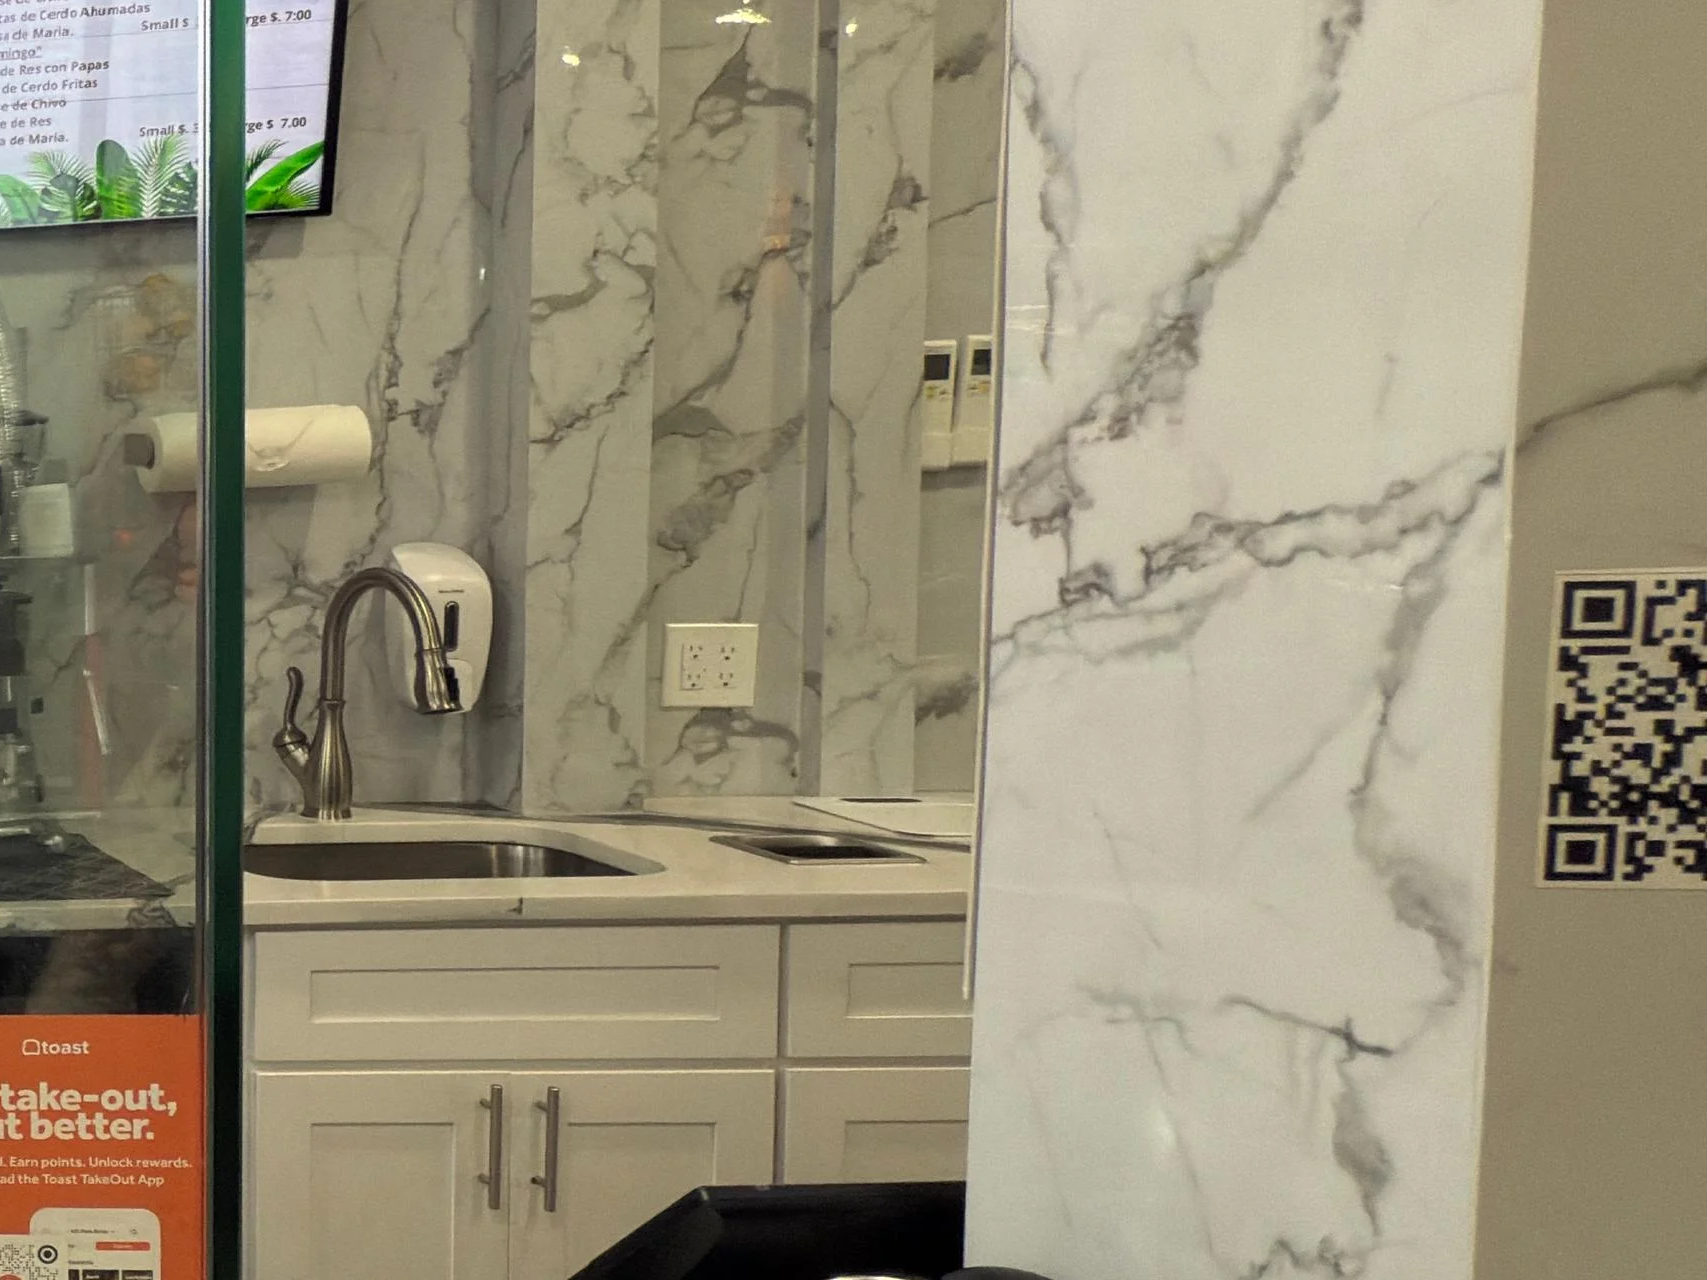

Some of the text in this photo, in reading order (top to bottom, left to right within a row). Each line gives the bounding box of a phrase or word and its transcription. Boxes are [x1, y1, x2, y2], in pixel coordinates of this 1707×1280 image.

[42, 1040, 90, 1055] toast
[30, 1112, 155, 1140] better.
[9, 1156, 38, 1168] Earn
[41, 1157, 85, 1169] points.
[88, 1157, 133, 1168] Unlock
[136, 1157, 192, 1168] rewards.
[17, 1173, 39, 1185] the
[42, 1173, 78, 1185] Toast
[80, 1173, 136, 1185] TakeOut
[137, 1173, 165, 1187] App
